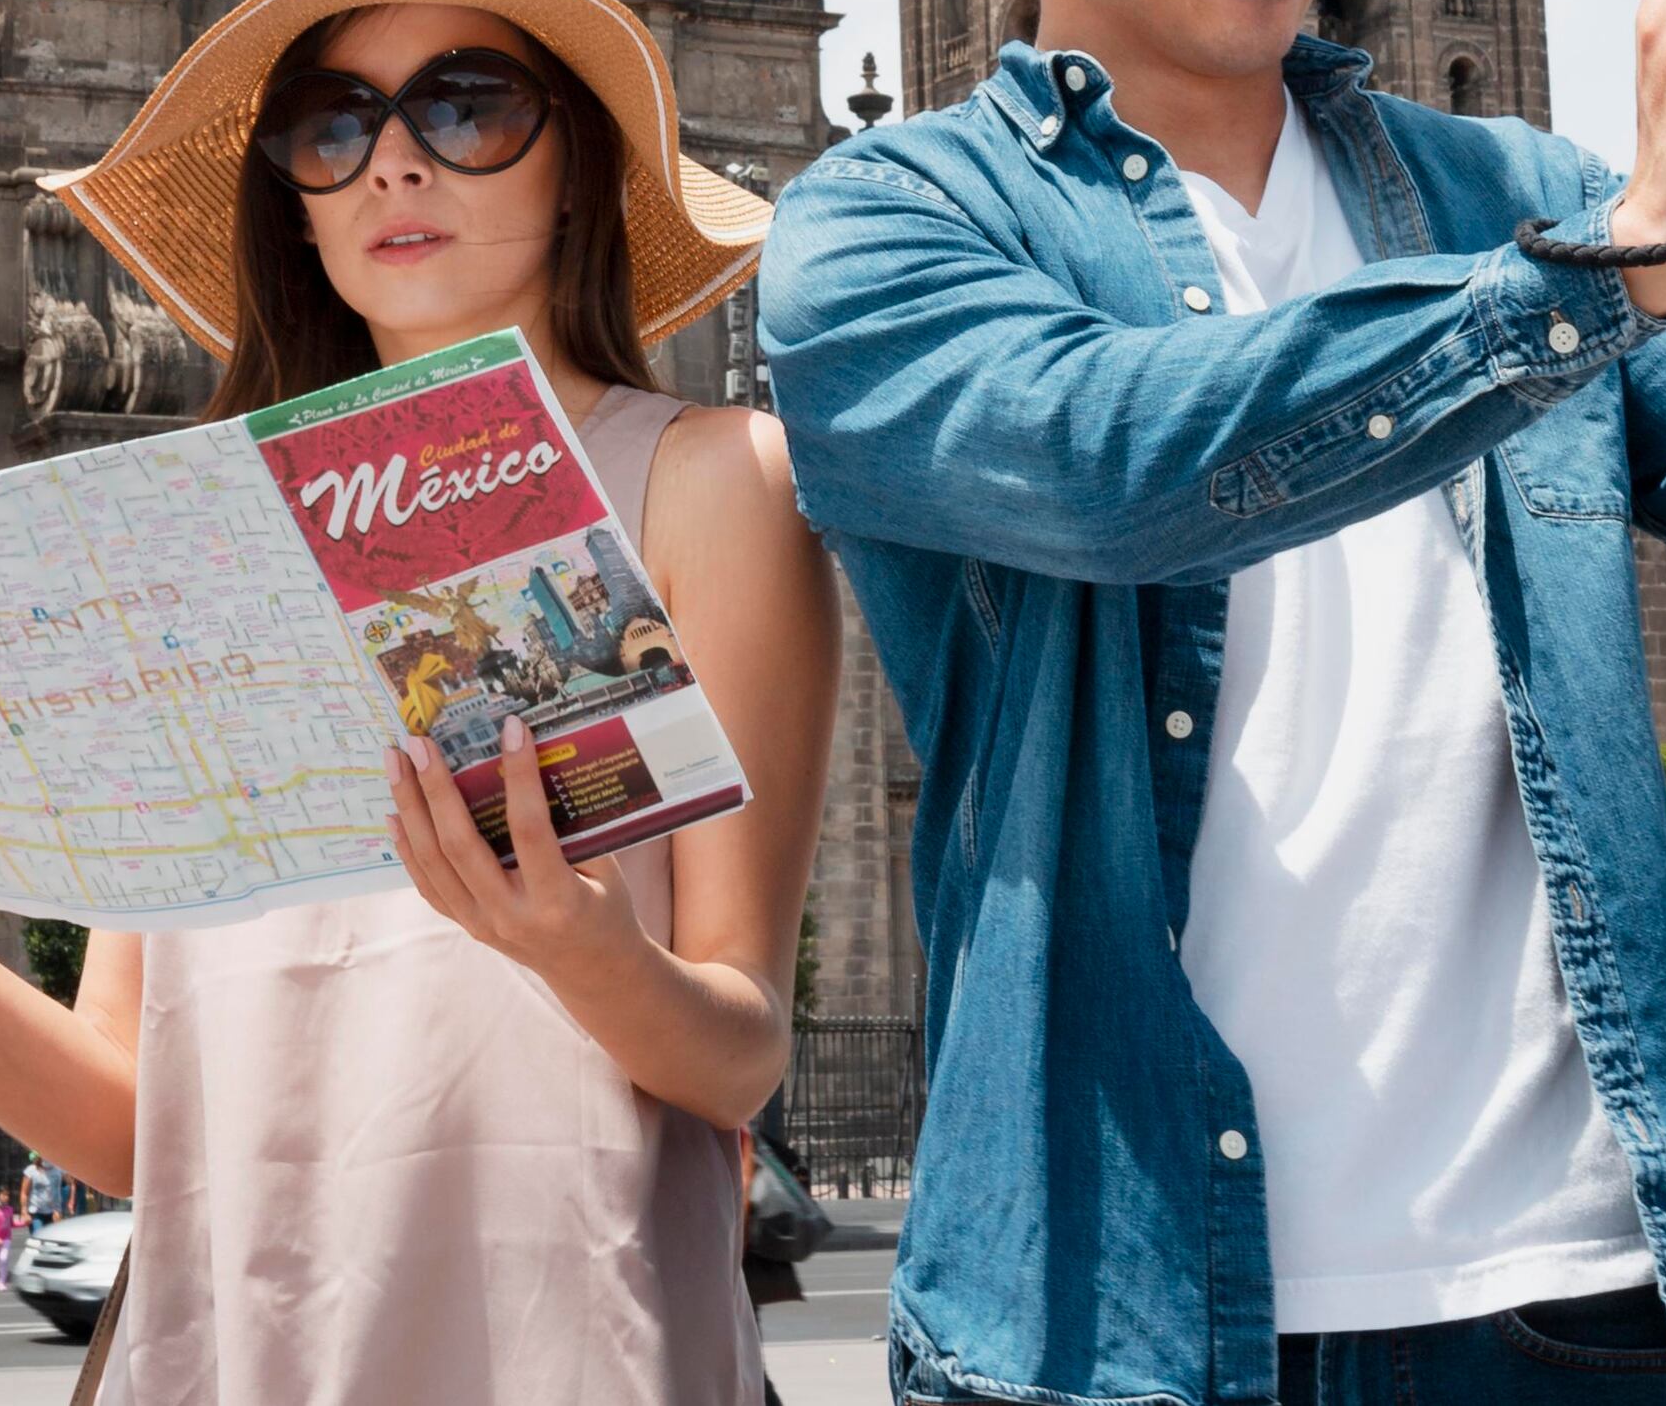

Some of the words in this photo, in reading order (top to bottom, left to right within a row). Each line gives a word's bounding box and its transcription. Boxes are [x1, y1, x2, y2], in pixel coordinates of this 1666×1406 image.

[302, 406, 334, 423] Plano
[337, 401, 349, 412] de
[353, 394, 368, 407] La
[372, 379, 411, 402] Ciudad
[415, 376, 427, 387] de
[419, 429, 492, 467] Ciudad
[498, 423, 522, 439] de
[300, 441, 563, 541] México
[560, 770, 575, 779] San
[565, 775, 591, 787] Ciudad
[592, 758, 640, 779] Universitaria
[569, 782, 604, 797] Esquema
[604, 775, 619, 785] Vial
[574, 797, 589, 806] Red
[589, 792, 601, 801] del
[602, 784, 625, 796] Metro
[578, 806, 593, 815] Red
